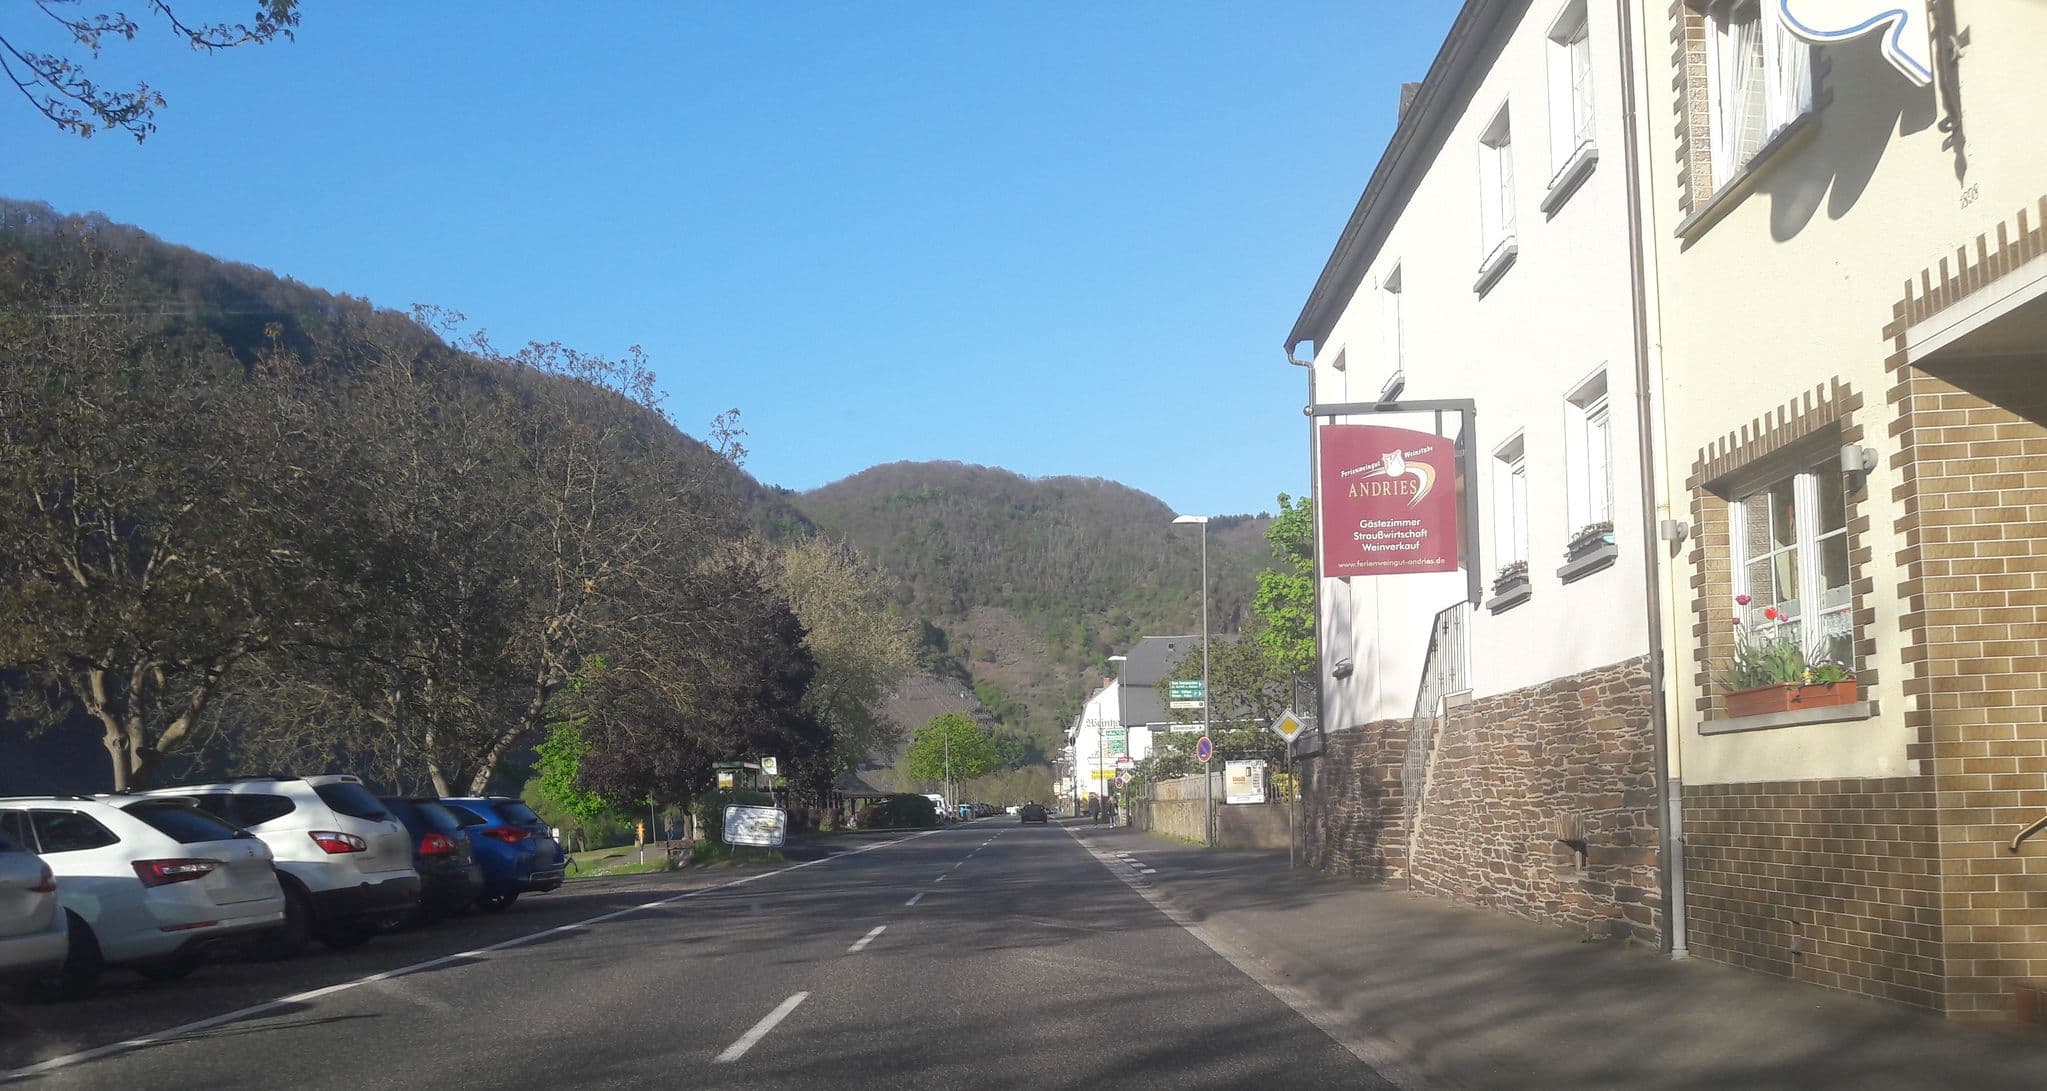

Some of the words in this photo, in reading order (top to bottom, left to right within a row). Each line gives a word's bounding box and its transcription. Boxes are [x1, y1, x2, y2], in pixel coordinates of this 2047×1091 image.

[1341, 461, 1381, 477] Ferienweingut
[1348, 480, 1417, 498] ANDRIES
[1360, 519, 1421, 529] Gästezimmer
[1353, 528, 1428, 541] Straußwirtschaft
[1362, 540, 1421, 552] Weinverkauf
[1337, 557, 1445, 568] www.ferienweingut-andries.de
